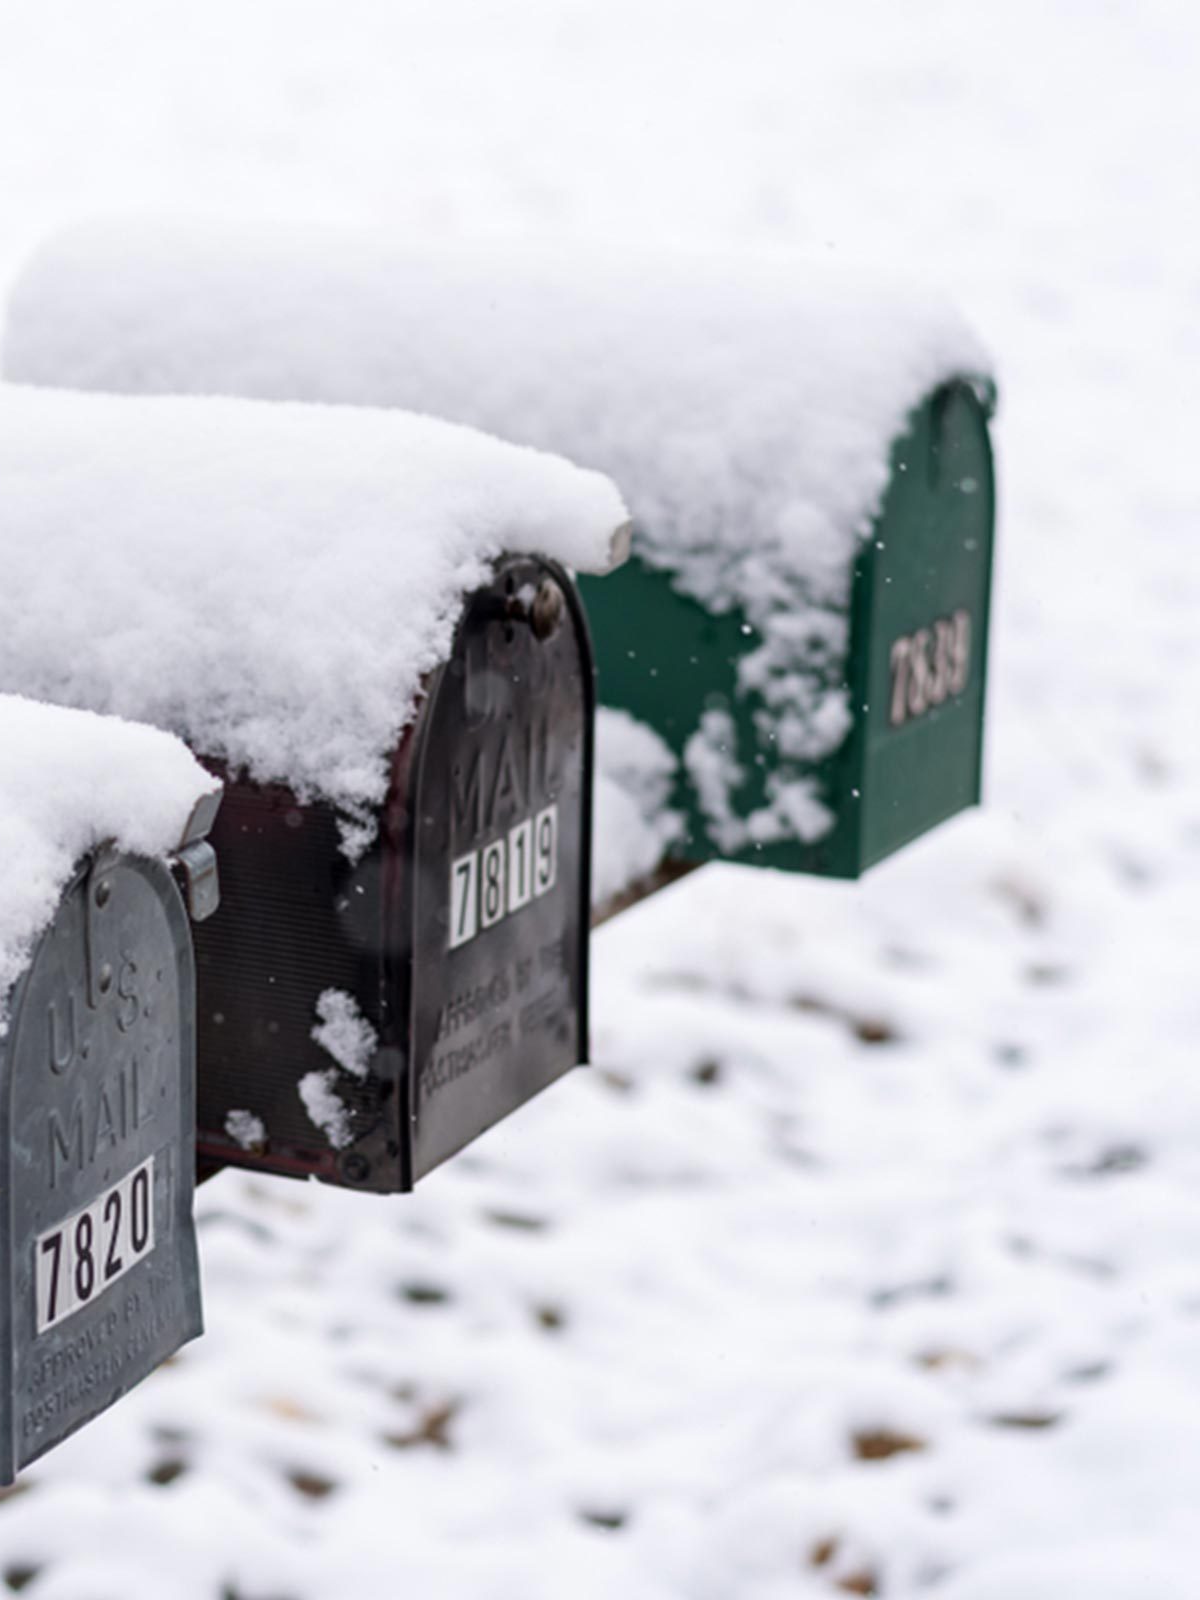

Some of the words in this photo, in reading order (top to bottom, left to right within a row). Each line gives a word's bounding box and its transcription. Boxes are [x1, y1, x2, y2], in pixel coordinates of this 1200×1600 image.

[455, 812, 557, 938] 7819
[49, 1055, 155, 1189] MAIL
[40, 1166, 149, 1322] 7820
